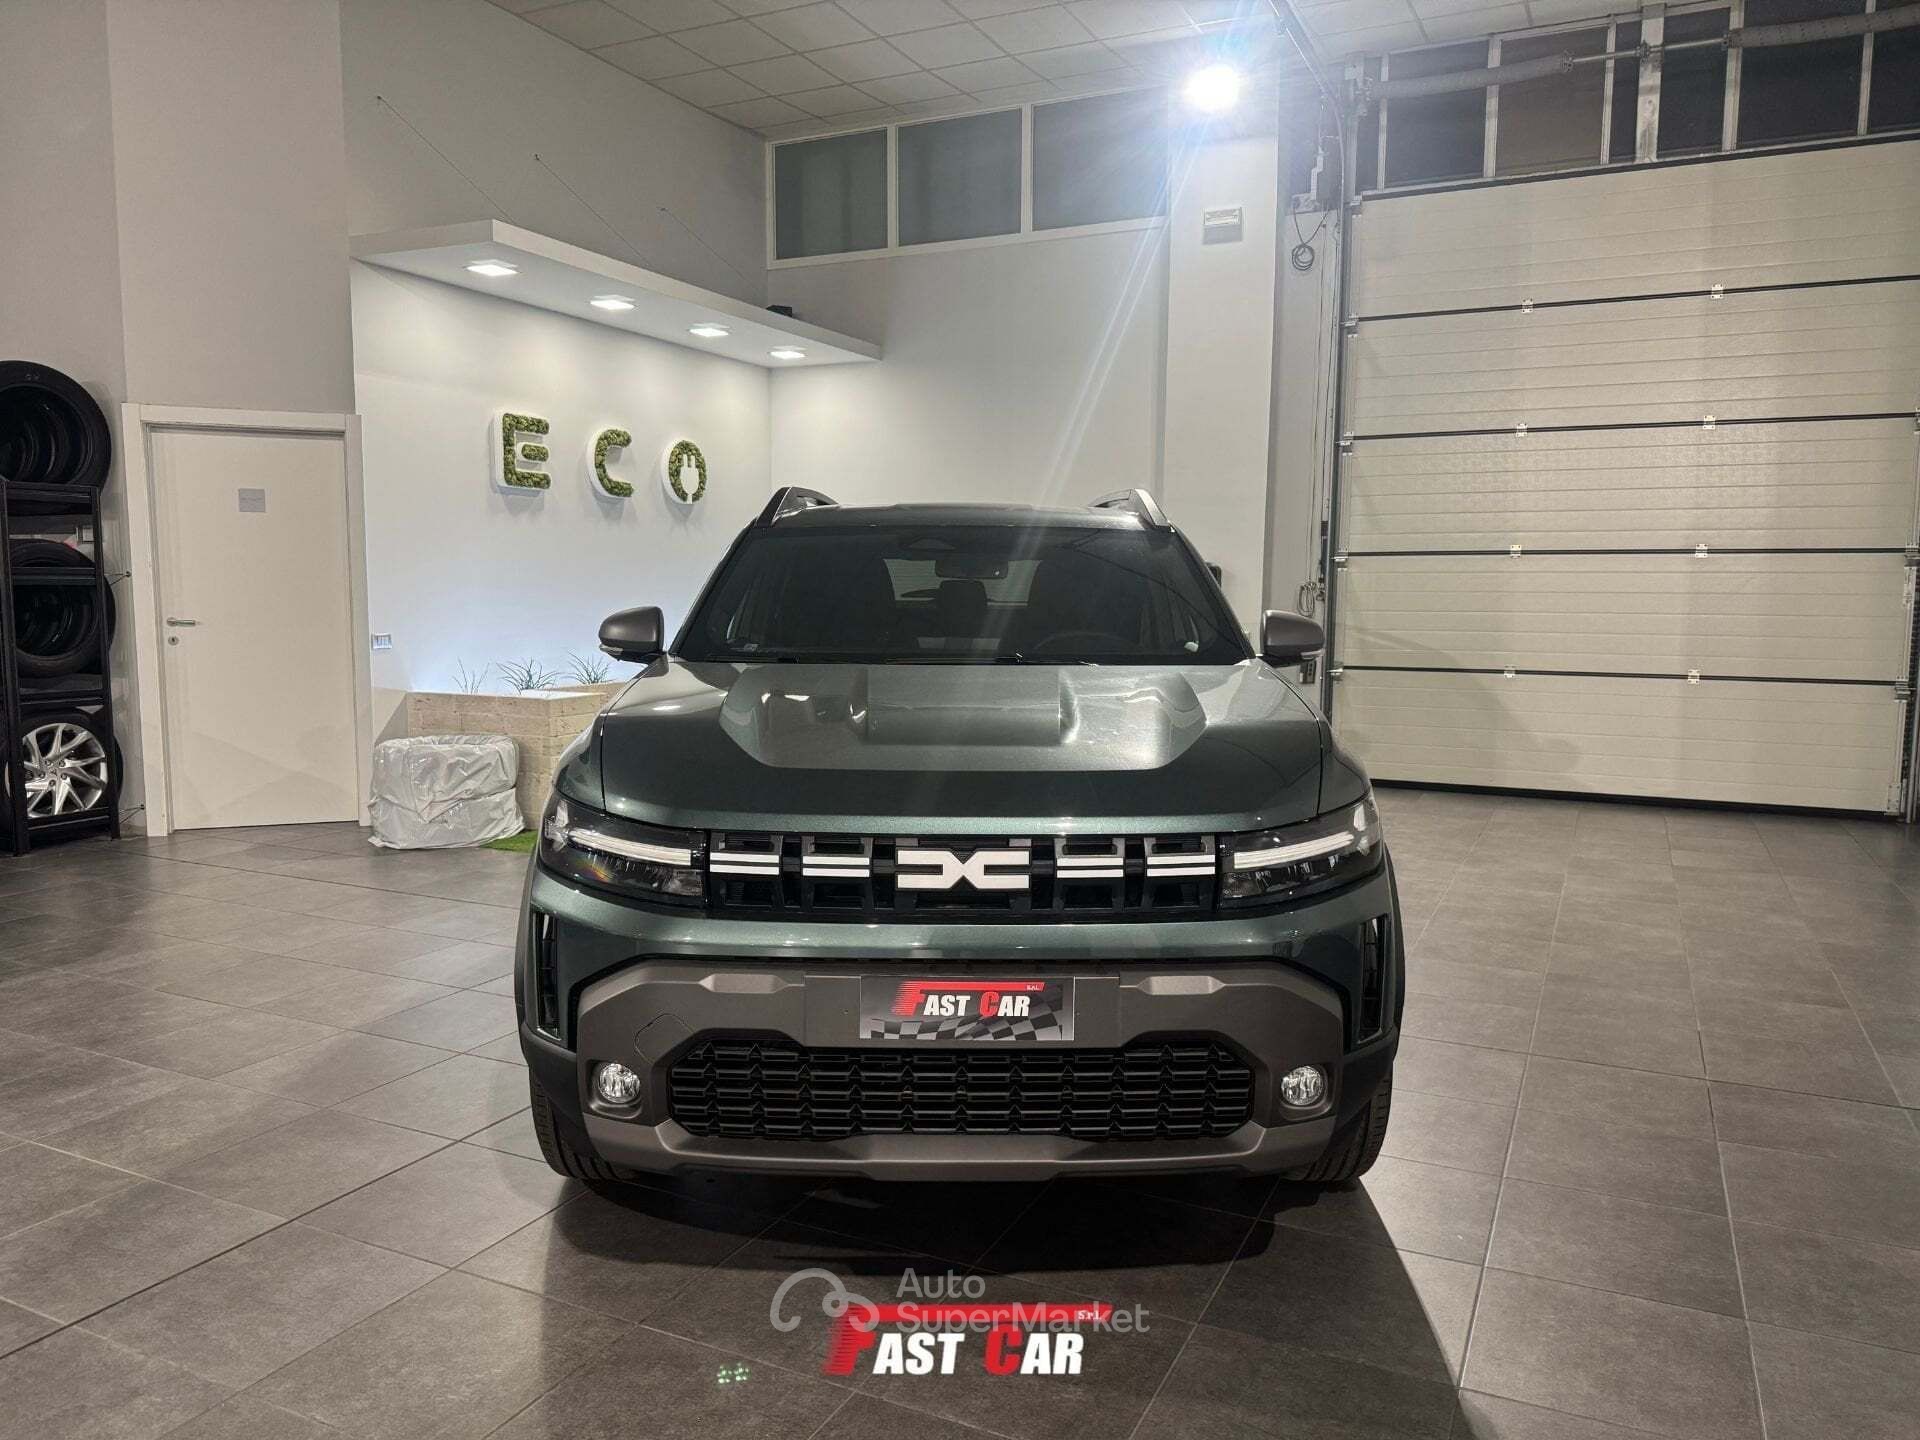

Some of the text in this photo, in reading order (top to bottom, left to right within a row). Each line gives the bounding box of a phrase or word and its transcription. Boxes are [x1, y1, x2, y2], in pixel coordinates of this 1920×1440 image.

[492, 409, 707, 505] ECO
[892, 981, 1030, 1018] FAST CAR
